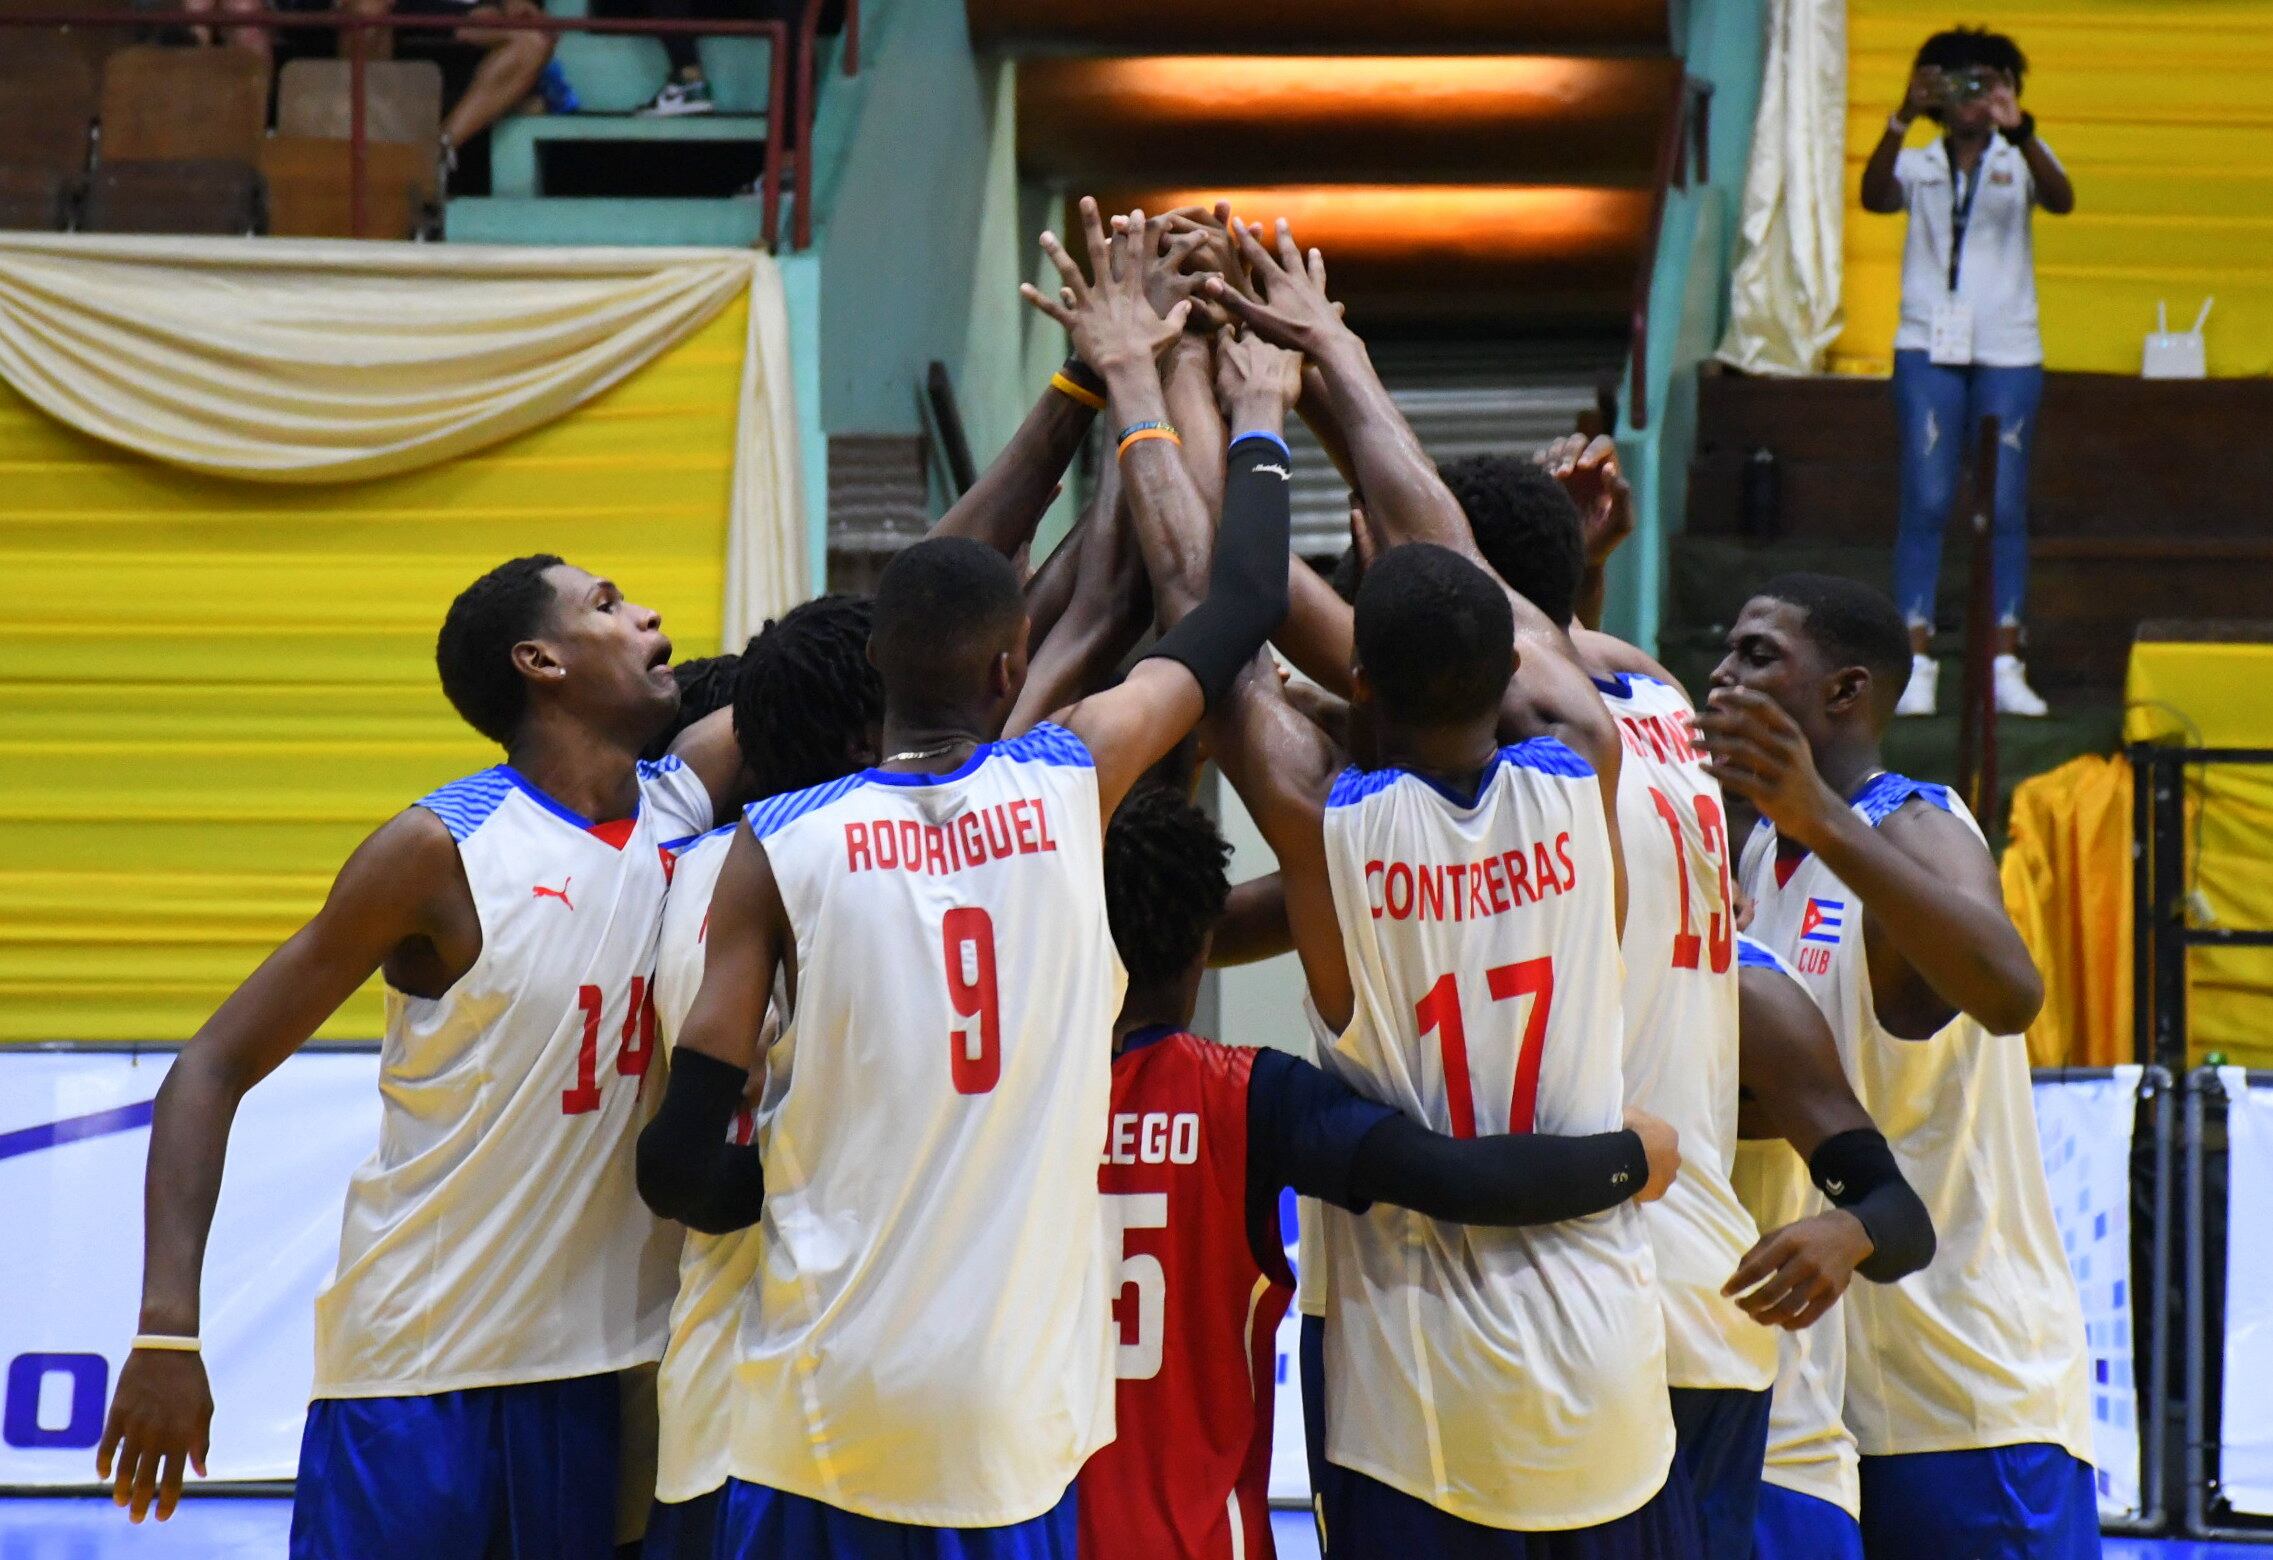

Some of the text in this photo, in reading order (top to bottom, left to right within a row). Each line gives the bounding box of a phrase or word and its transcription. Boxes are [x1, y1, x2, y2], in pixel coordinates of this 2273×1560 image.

[1365, 831, 1576, 922] CONTRERAS
[1648, 786, 1732, 974] 13
[942, 907, 1001, 1095] 9
[1798, 946, 1831, 976] CUB
[562, 975, 656, 1115] 14
[1415, 955, 1555, 1140] 17
